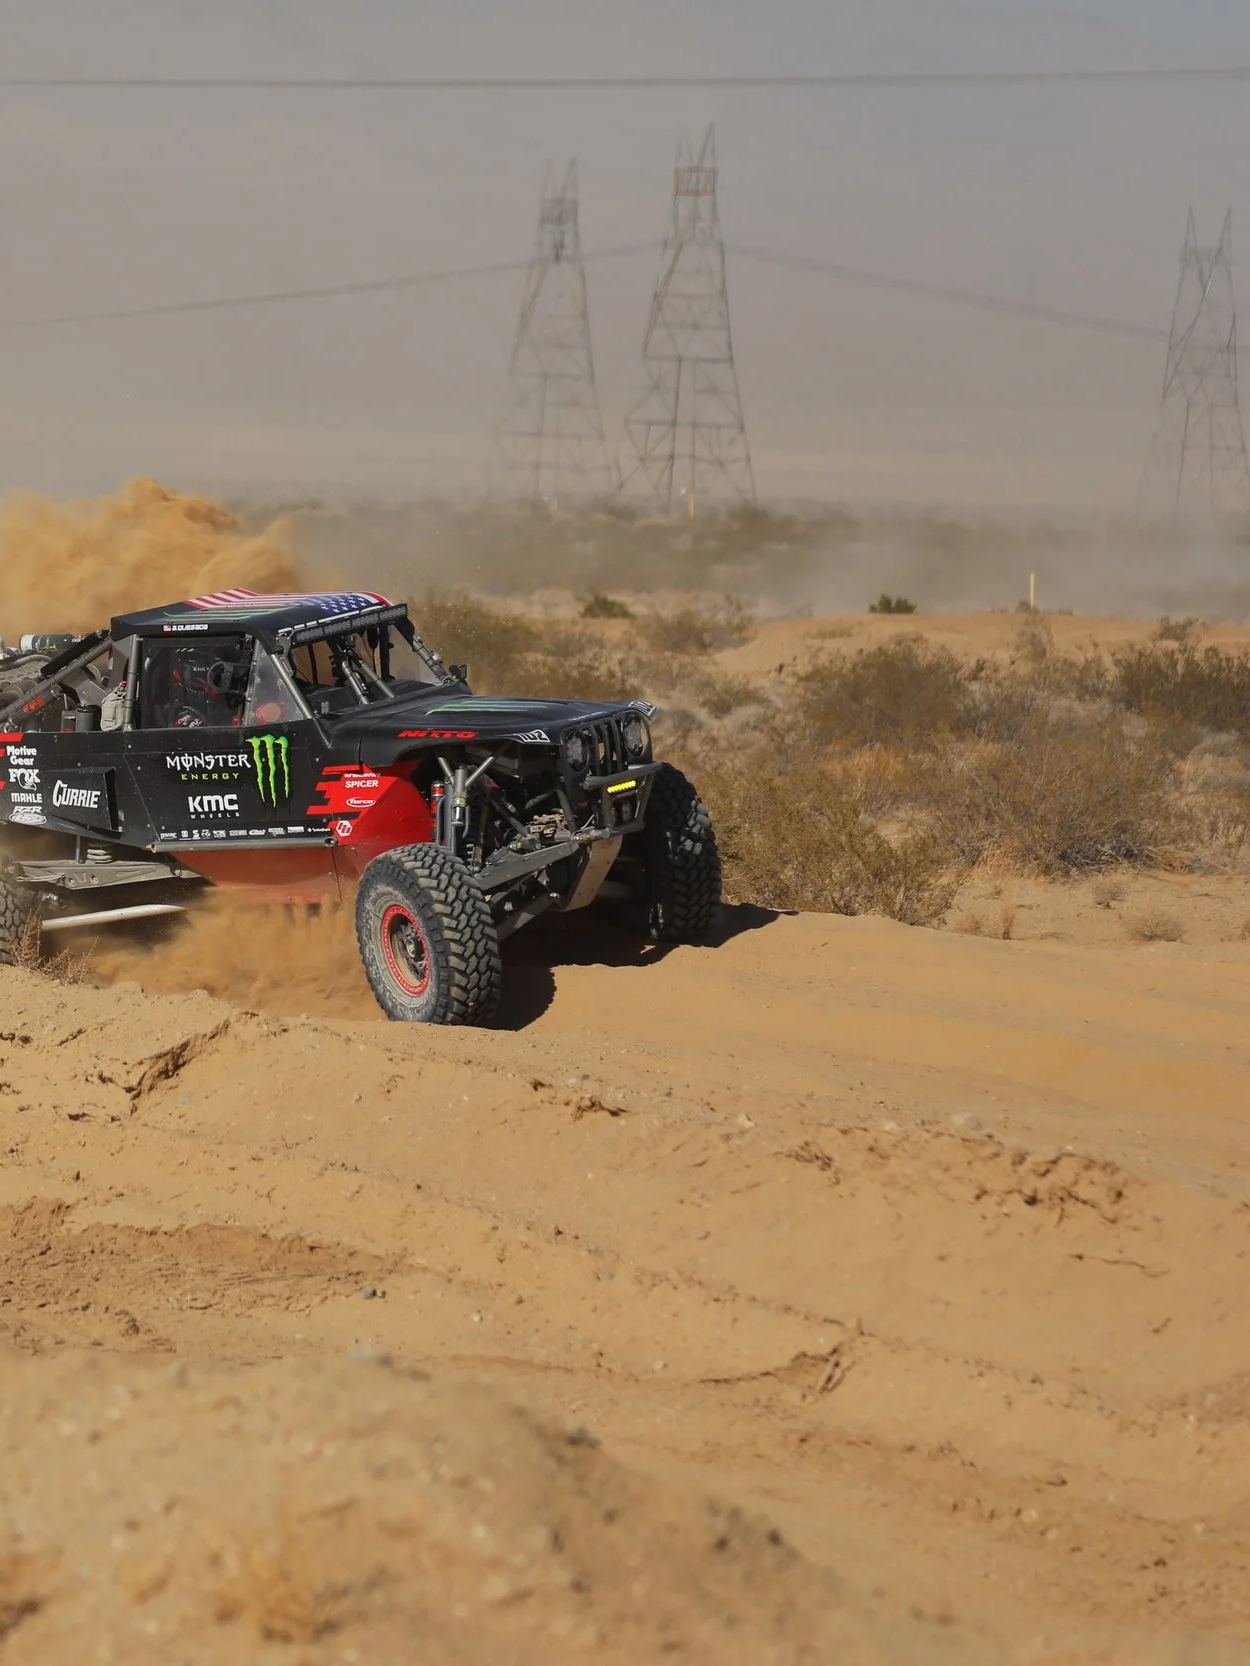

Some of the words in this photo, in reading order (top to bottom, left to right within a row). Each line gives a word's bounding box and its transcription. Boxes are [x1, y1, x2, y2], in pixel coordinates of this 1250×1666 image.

[398, 729, 477, 739] NITTO
[6, 745, 37, 756] Motive
[10, 756, 34, 766] Gear
[166, 752, 251, 771] MONSTER
[8, 768, 41, 791] FOX
[181, 772, 239, 780] ENERGY
[344, 780, 379, 789] SPICER
[11, 792, 43, 803] MAHLE
[52, 779, 101, 809] CURRIE
